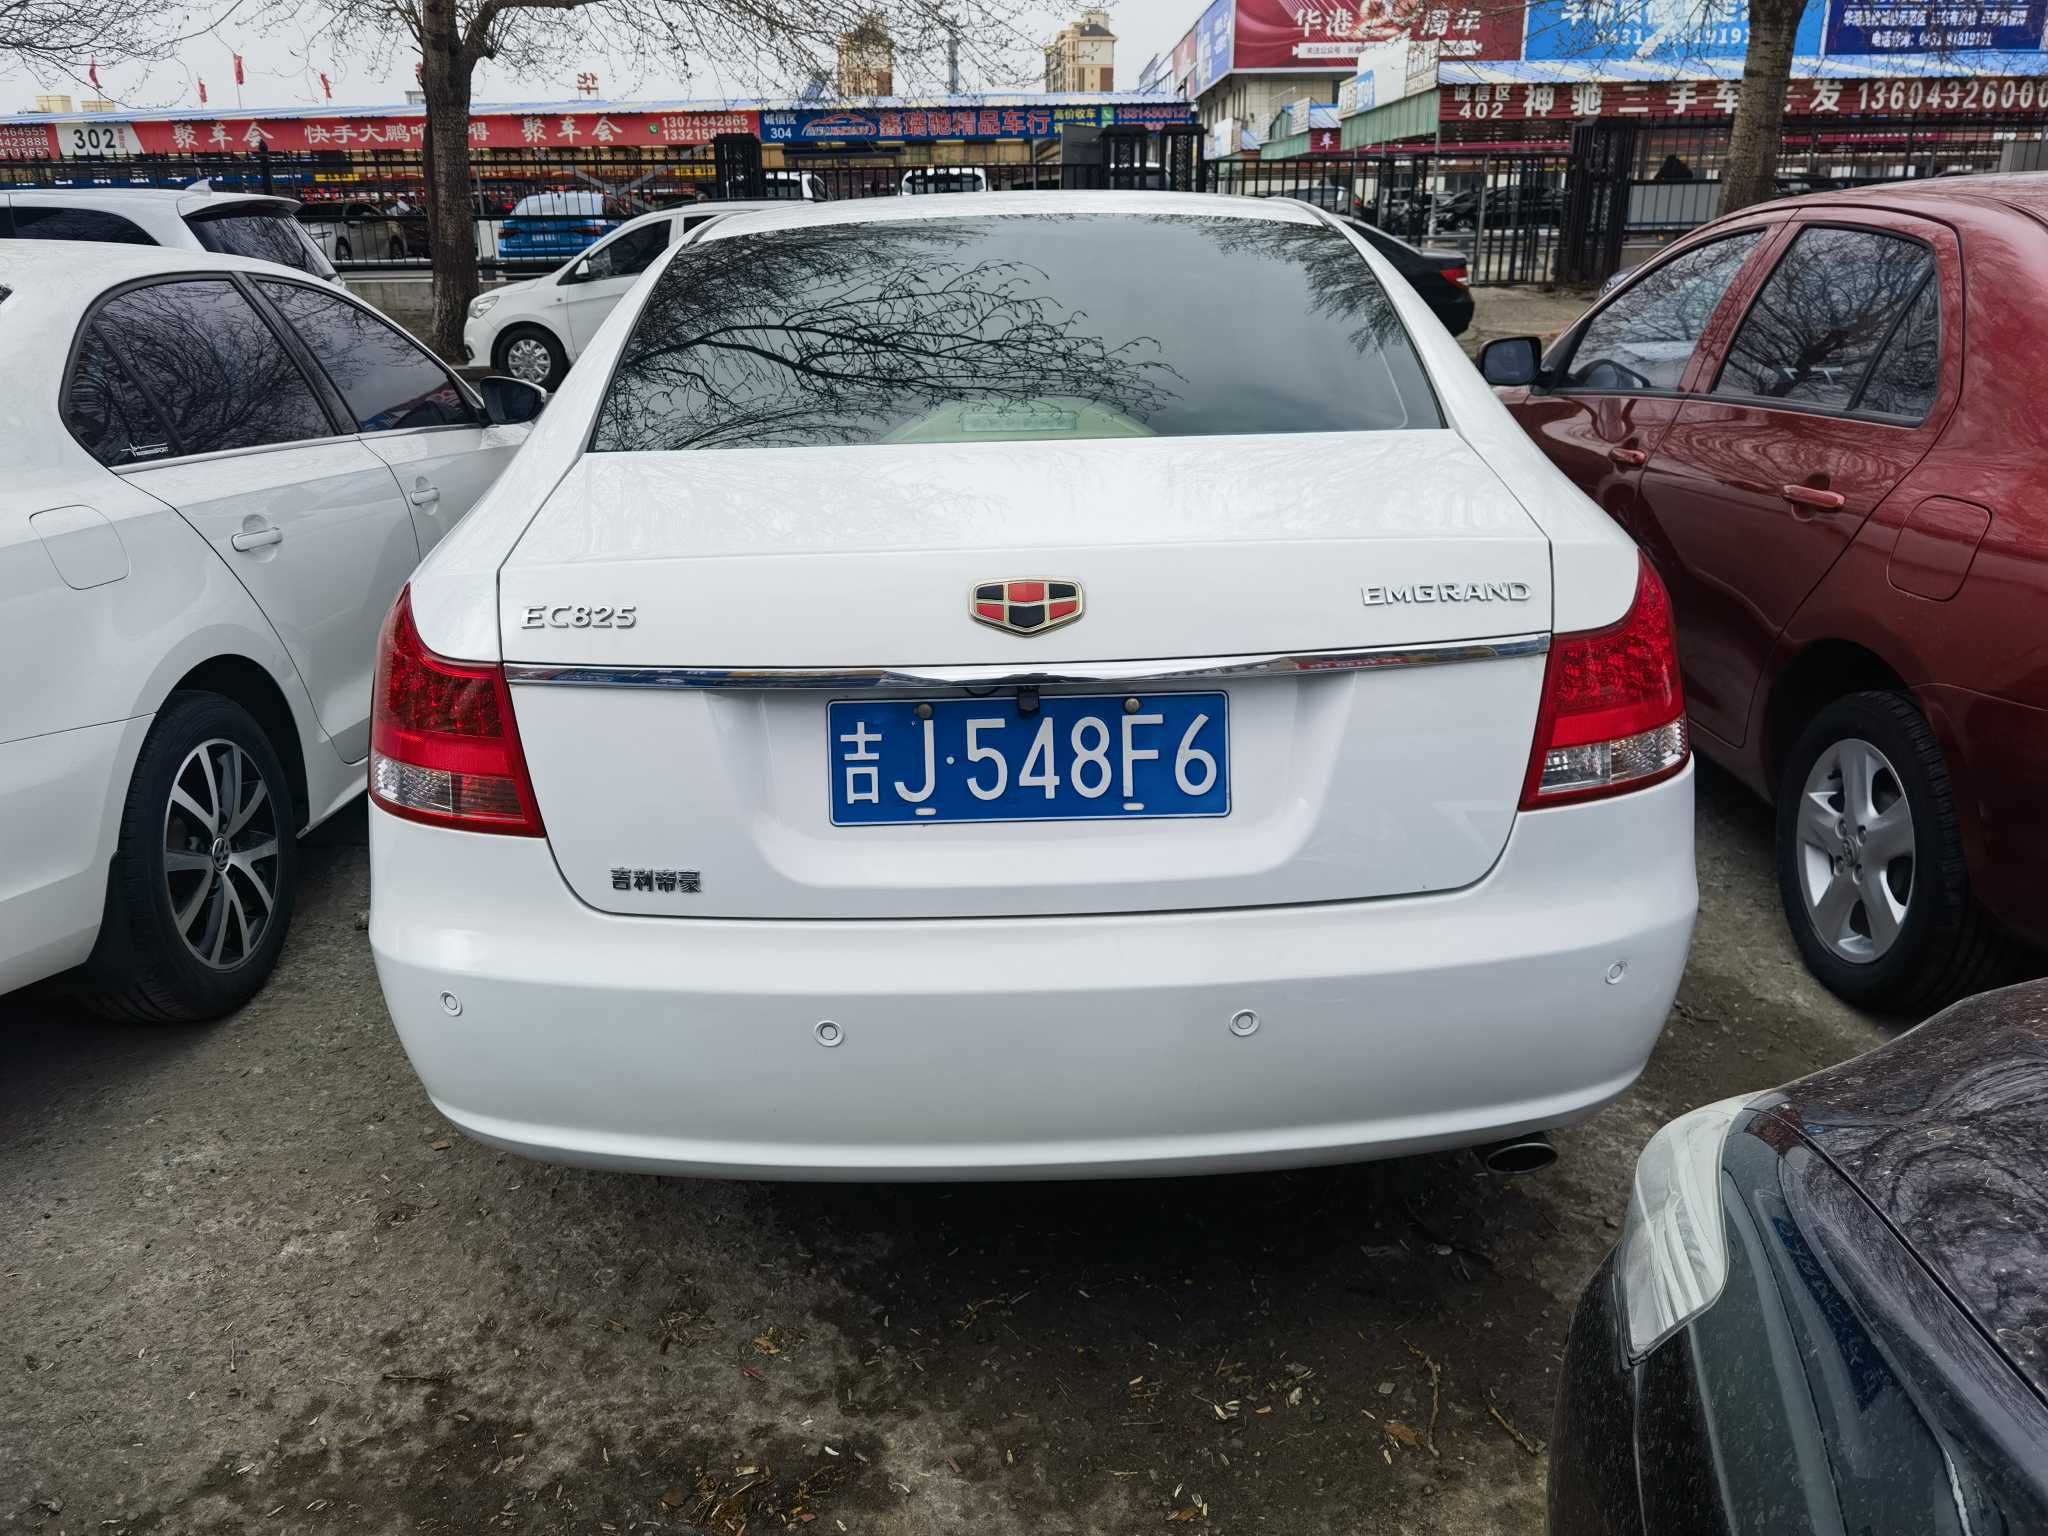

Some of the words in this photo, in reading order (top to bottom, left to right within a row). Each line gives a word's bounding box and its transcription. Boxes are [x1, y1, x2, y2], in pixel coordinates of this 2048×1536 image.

[1296, 8, 1352, 37] 华港
[1420, 8, 1481, 36] 周年
[1455, 85, 1511, 102] 诚信区
[1523, 80, 1843, 118] 神驰二手车发
[1459, 102, 1504, 119] 402
[662, 114, 748, 128] 13074342865
[763, 113, 797, 125] 诚信区
[880, 111, 1050, 137] 鑫瑞驰精品车行
[73, 128, 117, 149] 302
[172, 121, 274, 149] 聚车会
[521, 115, 623, 144] 聚车会
[770, 127, 792, 139] 304
[1361, 582, 1533, 606] EMGRAND
[521, 605, 637, 629] EC825
[610, 867, 702, 893] 吉利帝豪
